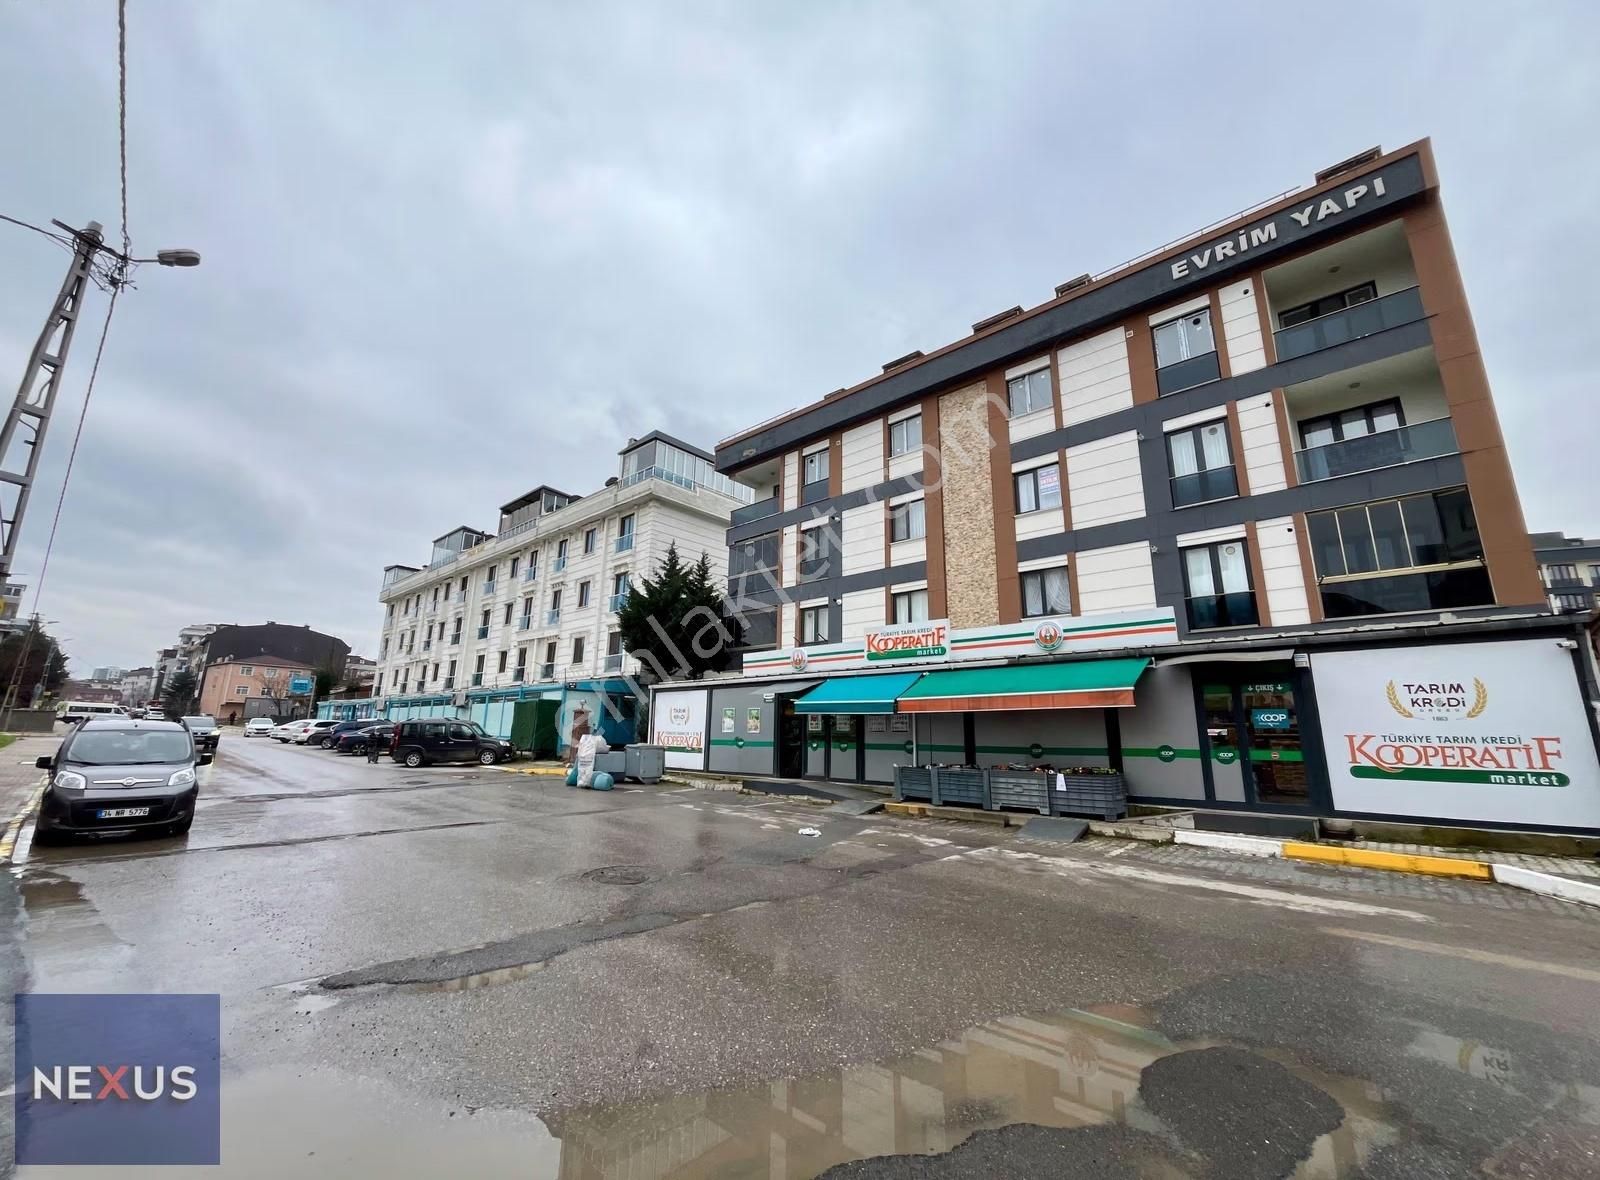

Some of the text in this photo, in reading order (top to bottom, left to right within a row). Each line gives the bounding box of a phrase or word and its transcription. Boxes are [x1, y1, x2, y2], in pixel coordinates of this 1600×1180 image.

[1171, 177, 1386, 280] EVRİM YAPI
[916, 648, 942, 656] market
[1403, 683, 1465, 694] TARIM
[1380, 733, 1522, 745] TÜRKİYE TARIM KREDİ
[1489, 773, 1560, 786] market
